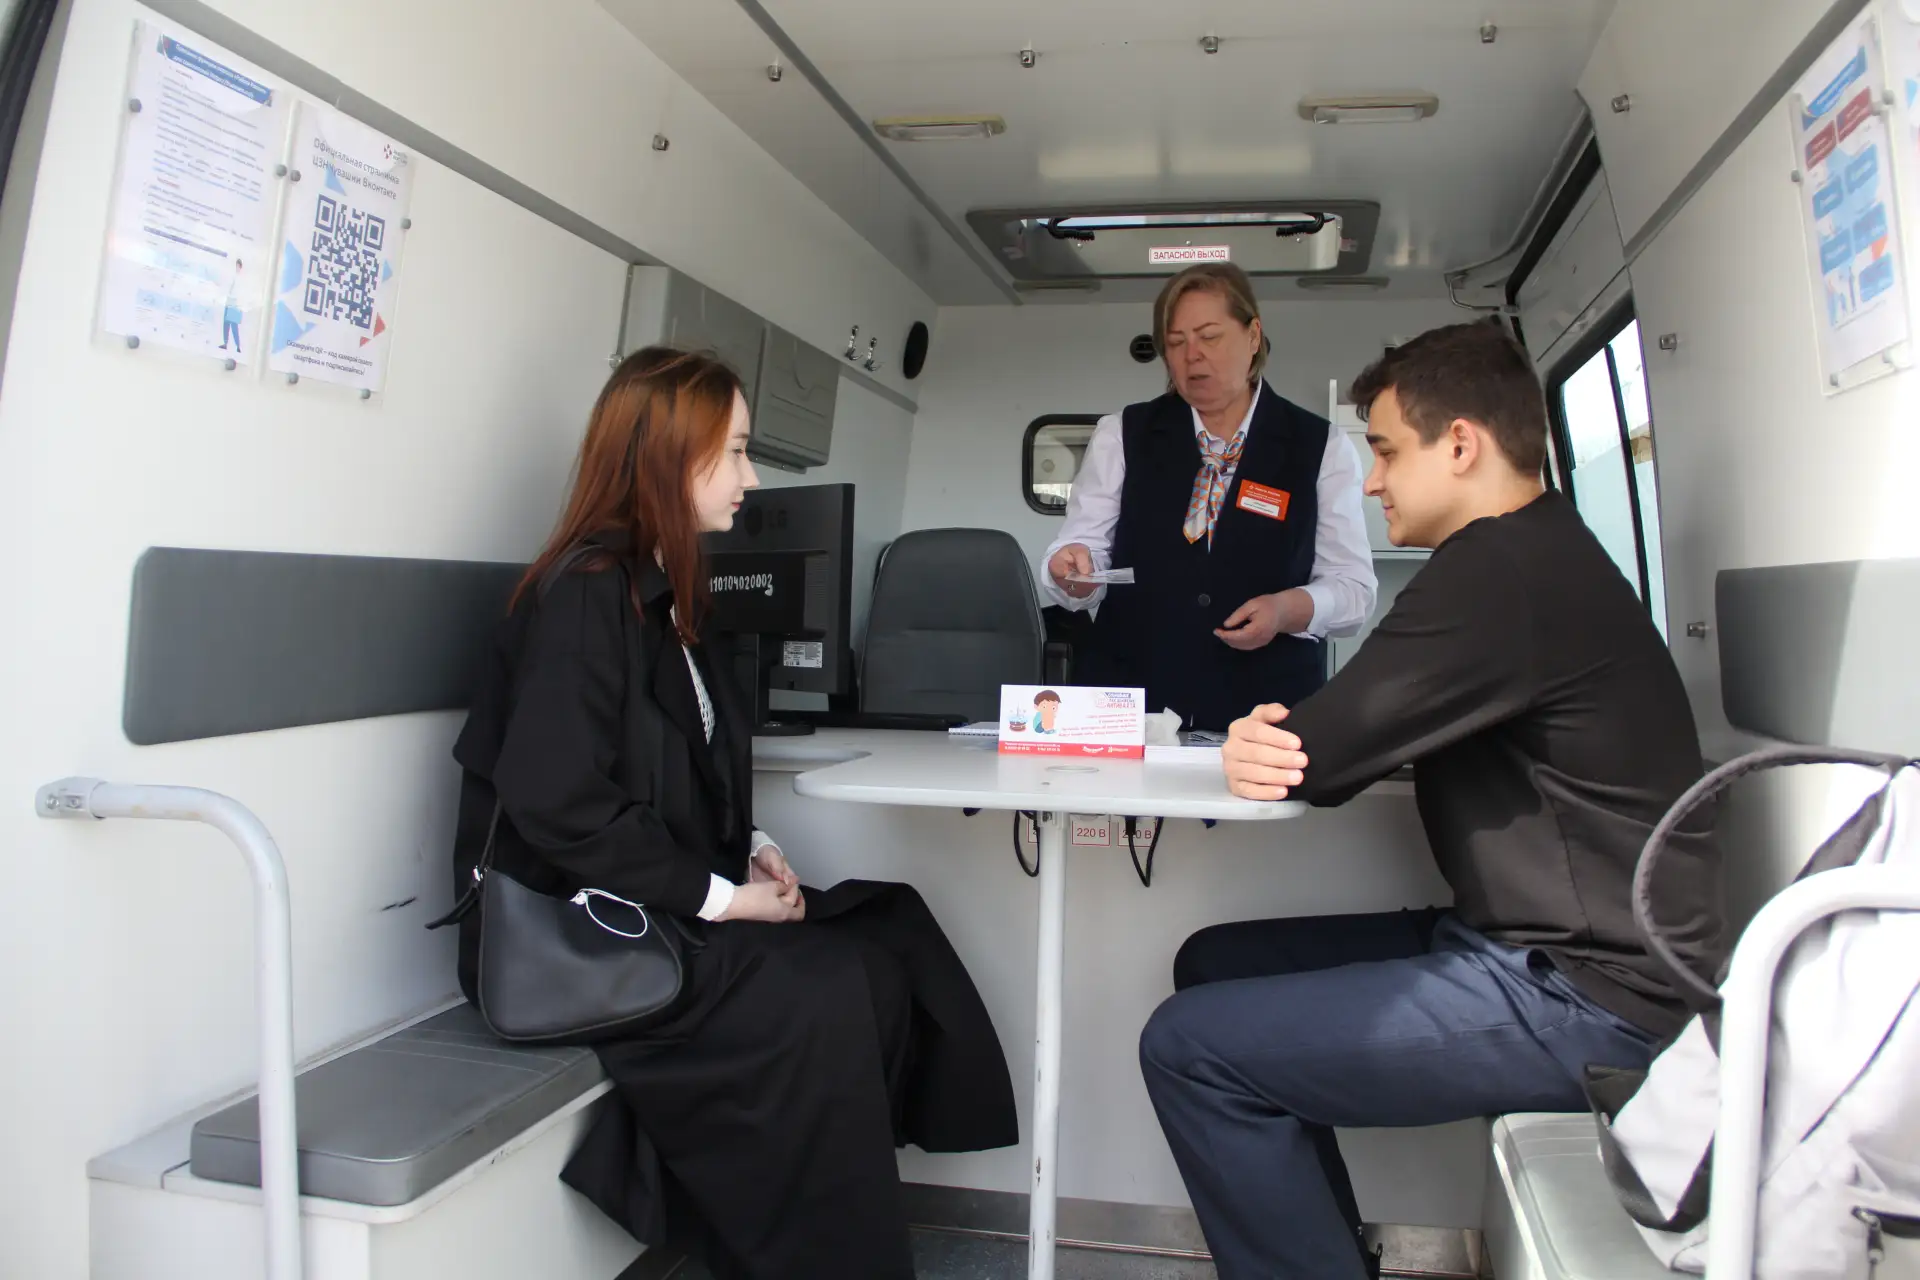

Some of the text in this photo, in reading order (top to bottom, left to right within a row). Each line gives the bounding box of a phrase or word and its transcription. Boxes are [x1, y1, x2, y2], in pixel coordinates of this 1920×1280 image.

[313, 137, 362, 169] Официальная
[363, 164, 400, 185] страничка
[312, 155, 328, 169] ЦЗН
[362, 177, 397, 200] Вконтакте
[1153, 249, 1226, 259] ЗАПАСНОЙ ВЫХОД
[768, 508, 788, 529] LG
[1076, 827, 1106, 838] 220 В
[1122, 830, 1141, 839] 20
